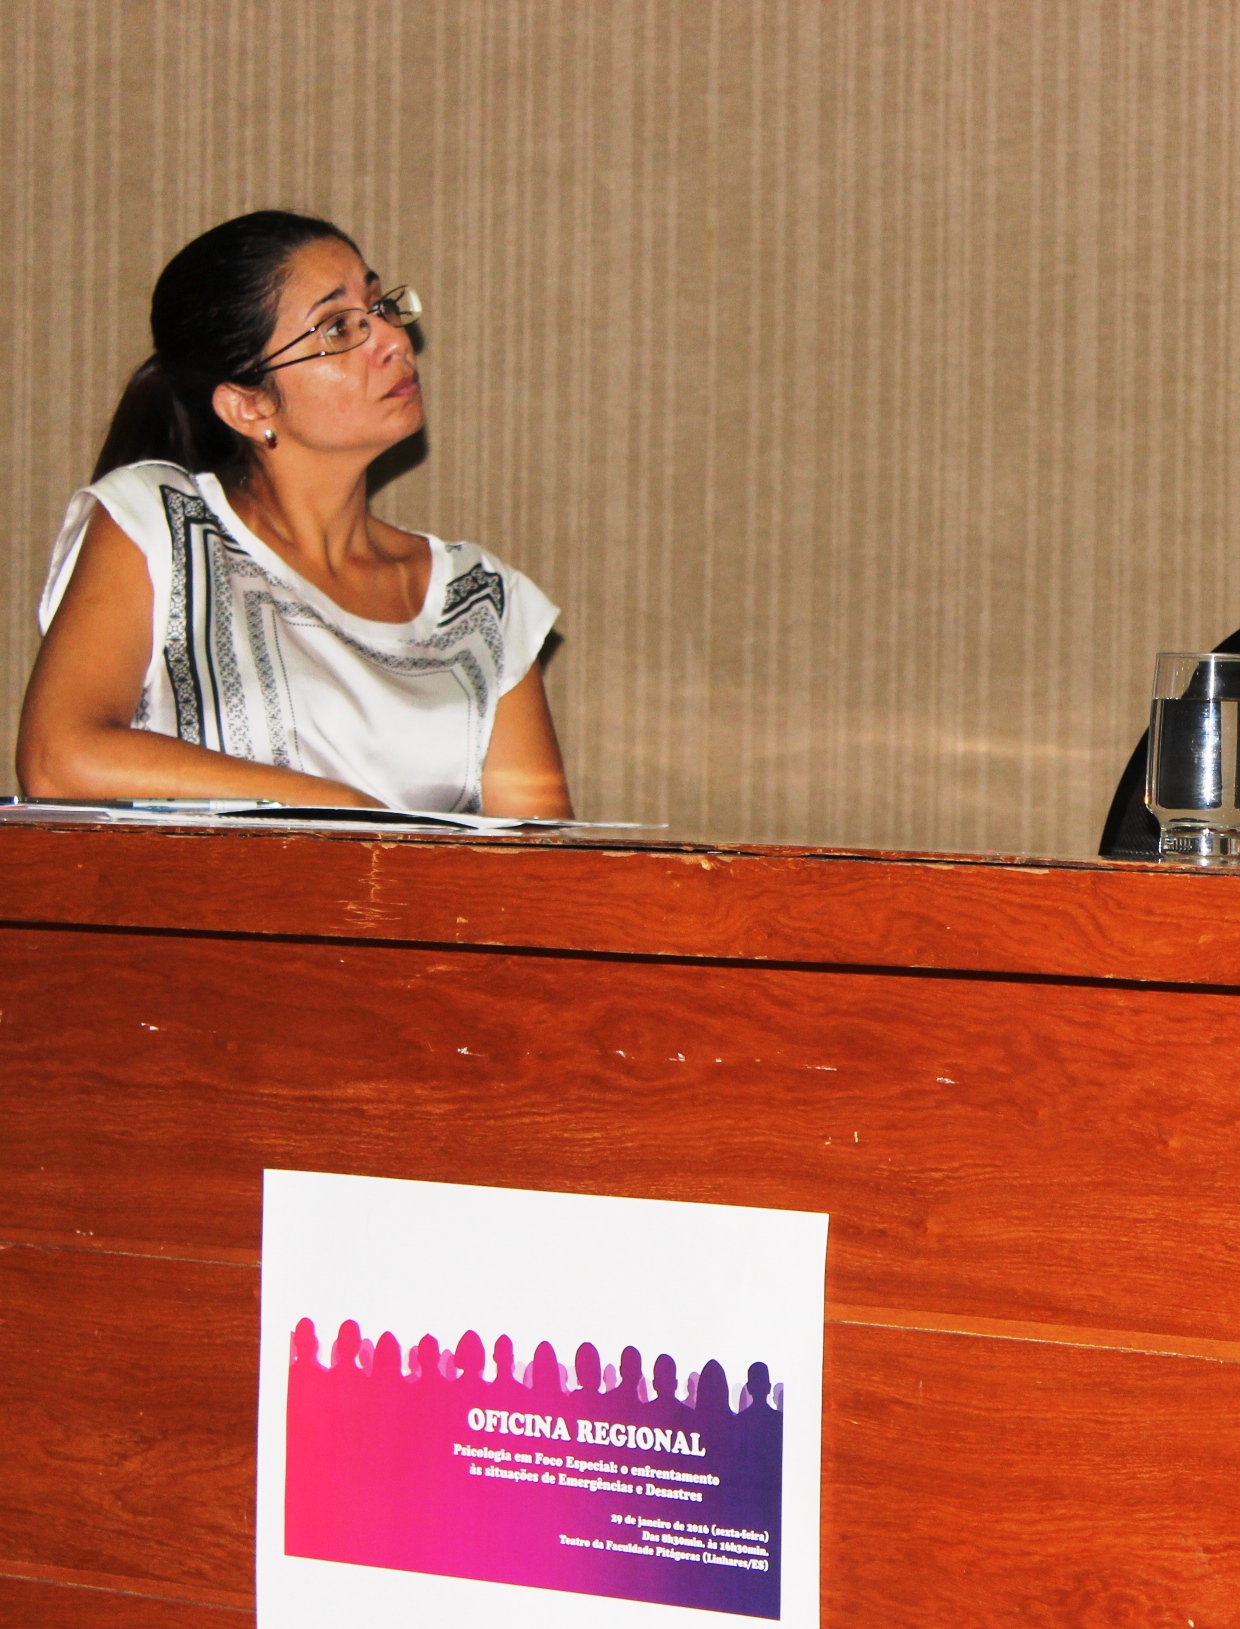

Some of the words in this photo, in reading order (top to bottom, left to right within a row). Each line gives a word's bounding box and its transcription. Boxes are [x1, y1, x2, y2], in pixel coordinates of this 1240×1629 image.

[468, 1408, 571, 1441] OFICINA
[577, 1420, 706, 1456] REGIONAL
[453, 1443, 512, 1462] Psicologia
[514, 1453, 532, 1464] em
[535, 1453, 563, 1467] Foco
[566, 1456, 618, 1474] Especial:
[620, 1466, 629, 1475] o
[631, 1465, 720, 1486] enfrentamento
[469, 1463, 482, 1476] às
[485, 1466, 539, 1483] situações
[541, 1472, 556, 1485] de
[558, 1473, 633, 1494] Emergências
[636, 1486, 643, 1495] e
[645, 1484, 703, 1502] Desastres
[611, 1514, 623, 1524] 29
[624, 1515, 637, 1525] de
[637, 1516, 671, 1530] janeiro
[673, 1521, 685, 1531] de
[687, 1524, 710, 1534] 2016
[711, 1524, 769, 1543] (sexta-feira)
[642, 1531, 660, 1542] Das
[661, 1534, 705, 1548] 8h30min.
[707, 1539, 717, 1550] às
[720, 1542, 769, 1556] 16h30min.
[559, 1534, 590, 1547] Teatro
[592, 1539, 604, 1550] da
[605, 1540, 654, 1556] Faculdade
[656, 1547, 700, 1562] Pitágoras
[702, 1552, 769, 1571] (Linhares/ES)
